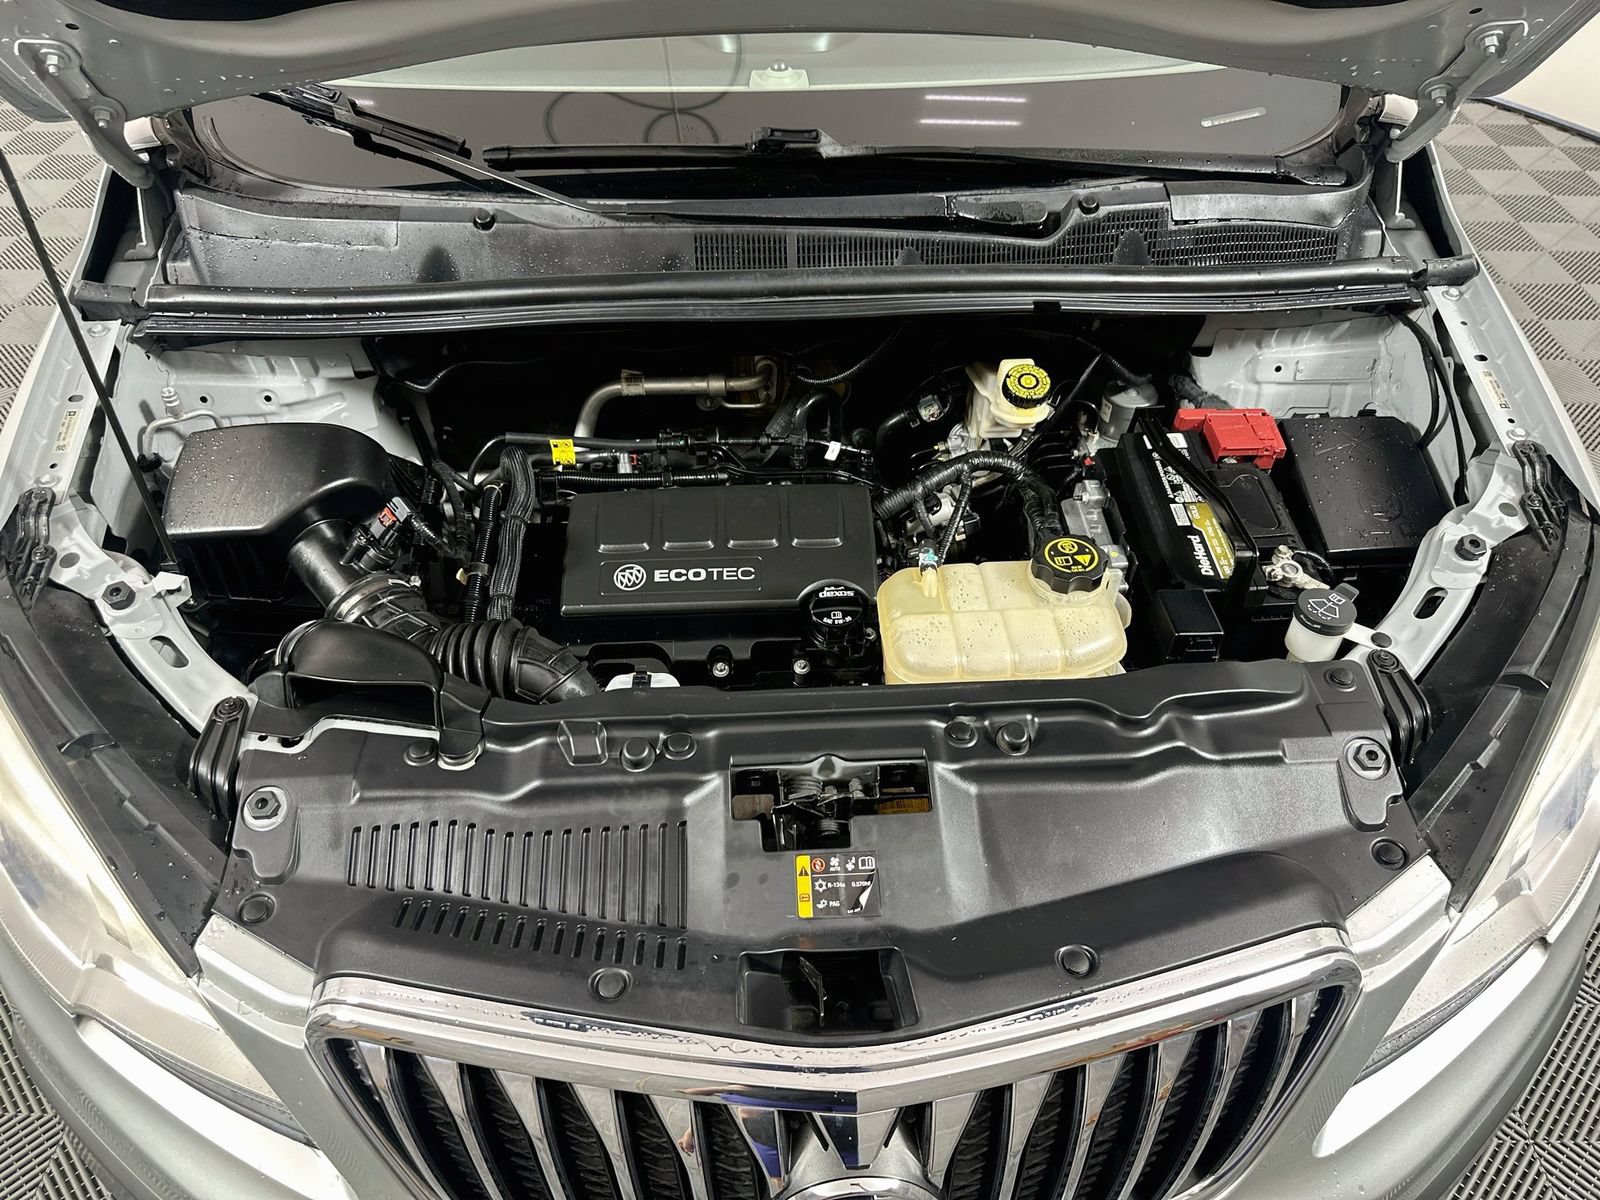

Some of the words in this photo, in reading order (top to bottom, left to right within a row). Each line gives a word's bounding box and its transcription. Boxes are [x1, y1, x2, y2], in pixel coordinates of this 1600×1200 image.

[1189, 504, 1201, 519] GOLD
[1187, 534, 1215, 576] DieHard
[653, 566, 756, 583] ECOTEC
[818, 589, 855, 598] dexos
